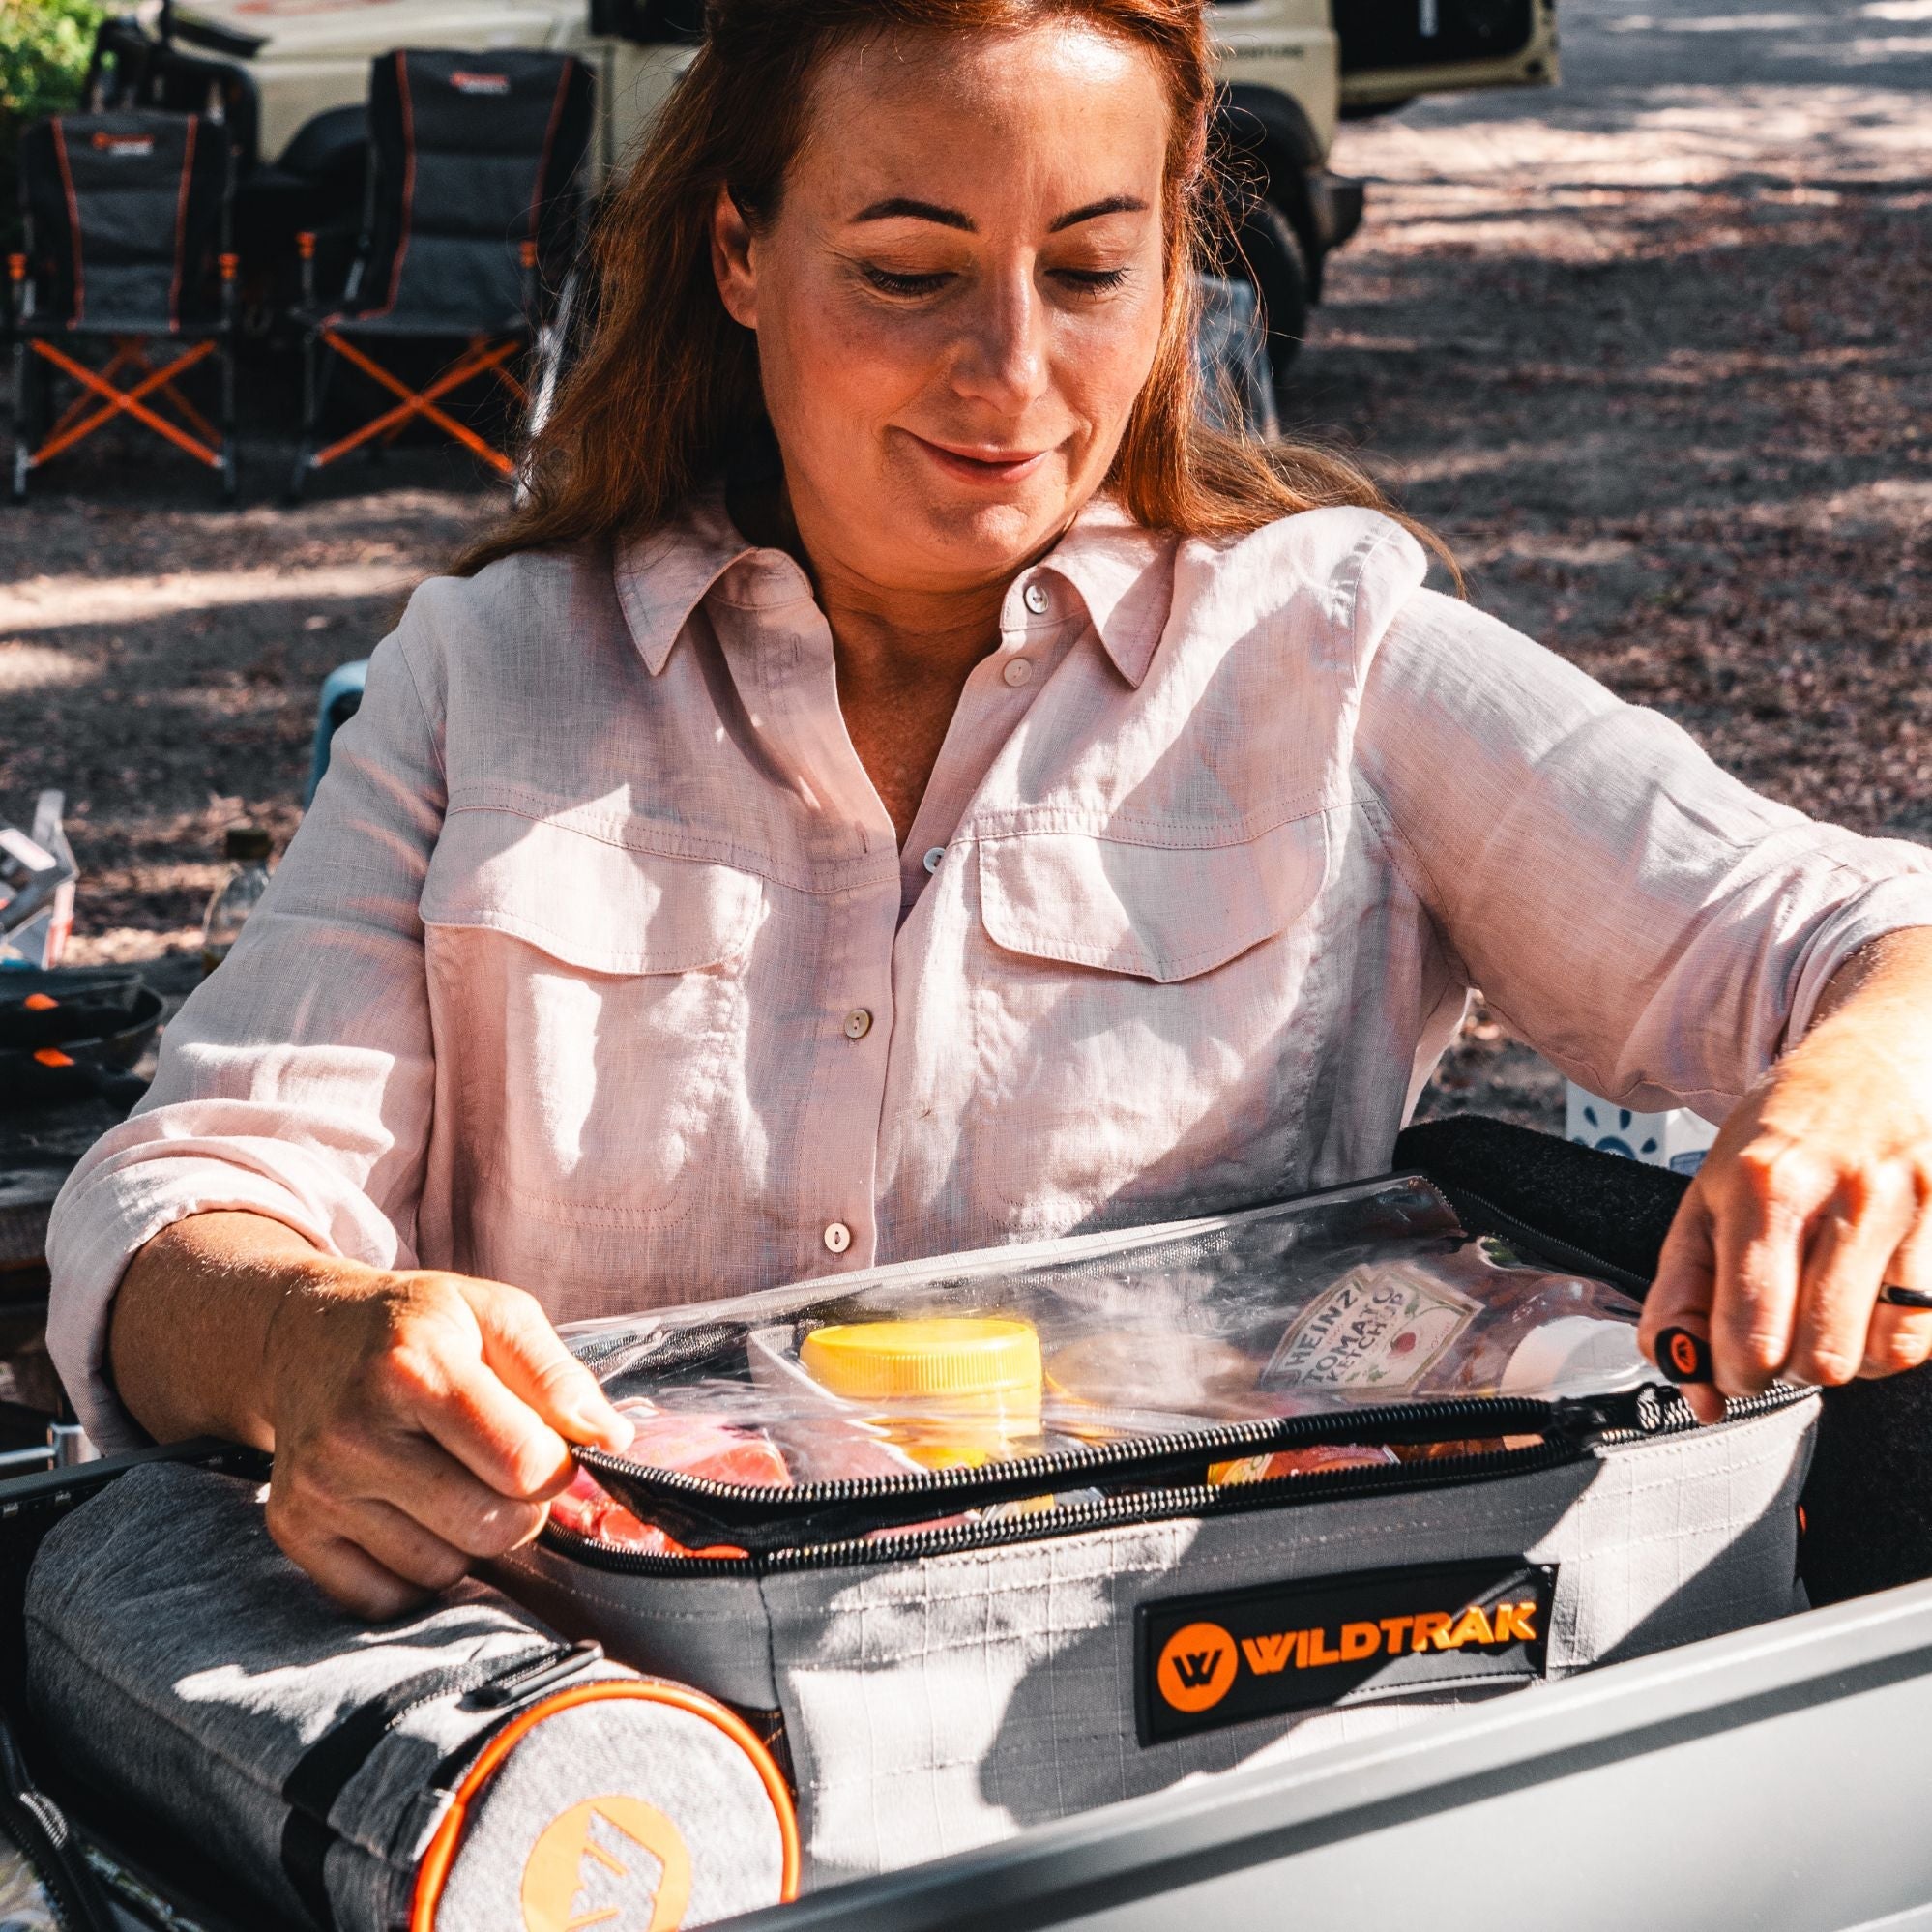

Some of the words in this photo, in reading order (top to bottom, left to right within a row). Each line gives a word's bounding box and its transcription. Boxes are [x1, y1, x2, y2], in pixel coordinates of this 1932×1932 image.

[1285, 1289, 1359, 1367] HEINZ
[1172, 1648, 1223, 1689] W
[1241, 1601, 1537, 1675] WILDTRAK
